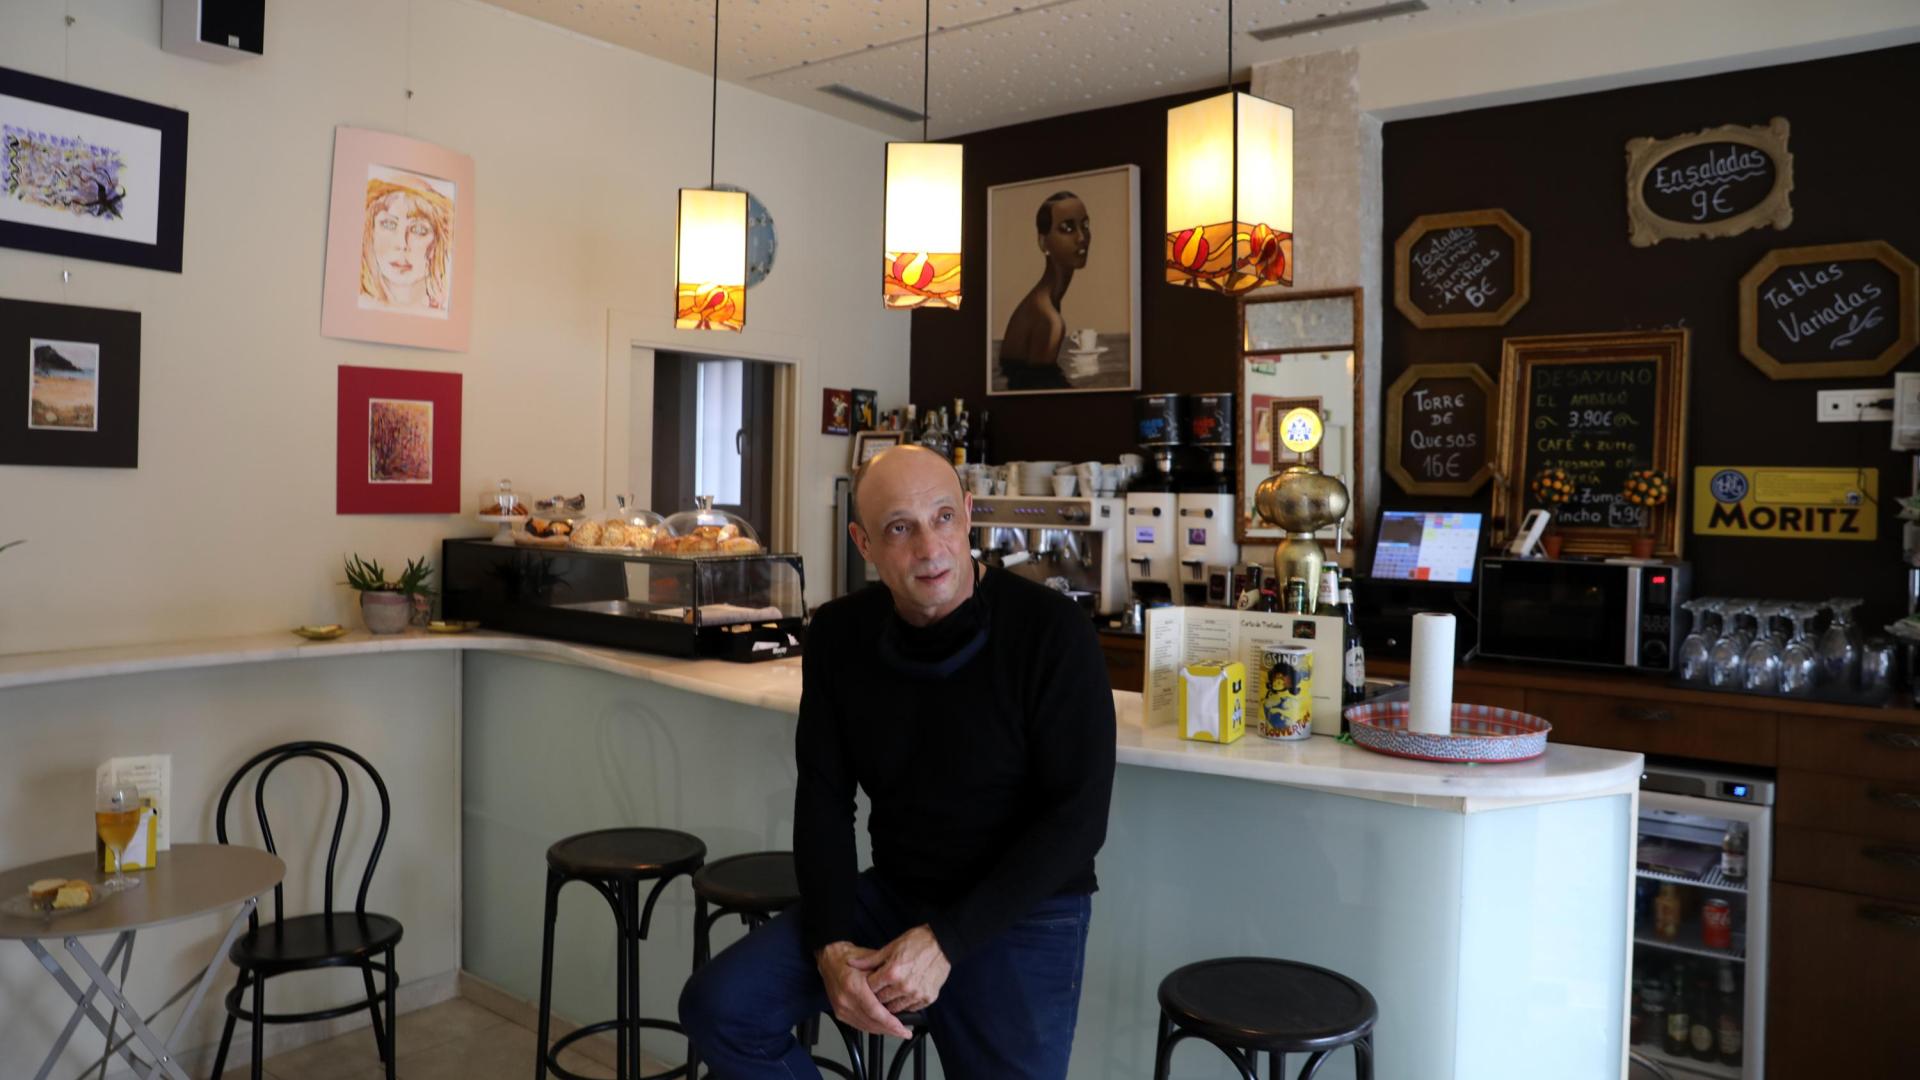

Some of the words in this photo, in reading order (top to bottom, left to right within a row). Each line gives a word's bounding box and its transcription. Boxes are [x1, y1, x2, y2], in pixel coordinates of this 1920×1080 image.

[1655, 145, 1765, 188] Ensaladas
[1691, 184, 1734, 220] 9€
[1465, 275, 1497, 308] 6€
[1763, 263, 1844, 310] Tablas
[1777, 283, 1882, 342] Variadas
[1536, 367, 1653, 389] DESAYUNO
[1413, 389, 1464, 412] TORRE
[1536, 393, 1558, 408] EL
[1430, 412, 1454, 426] DE
[1423, 453, 1461, 478] 16€
[1708, 502, 1860, 533] MORITZ
